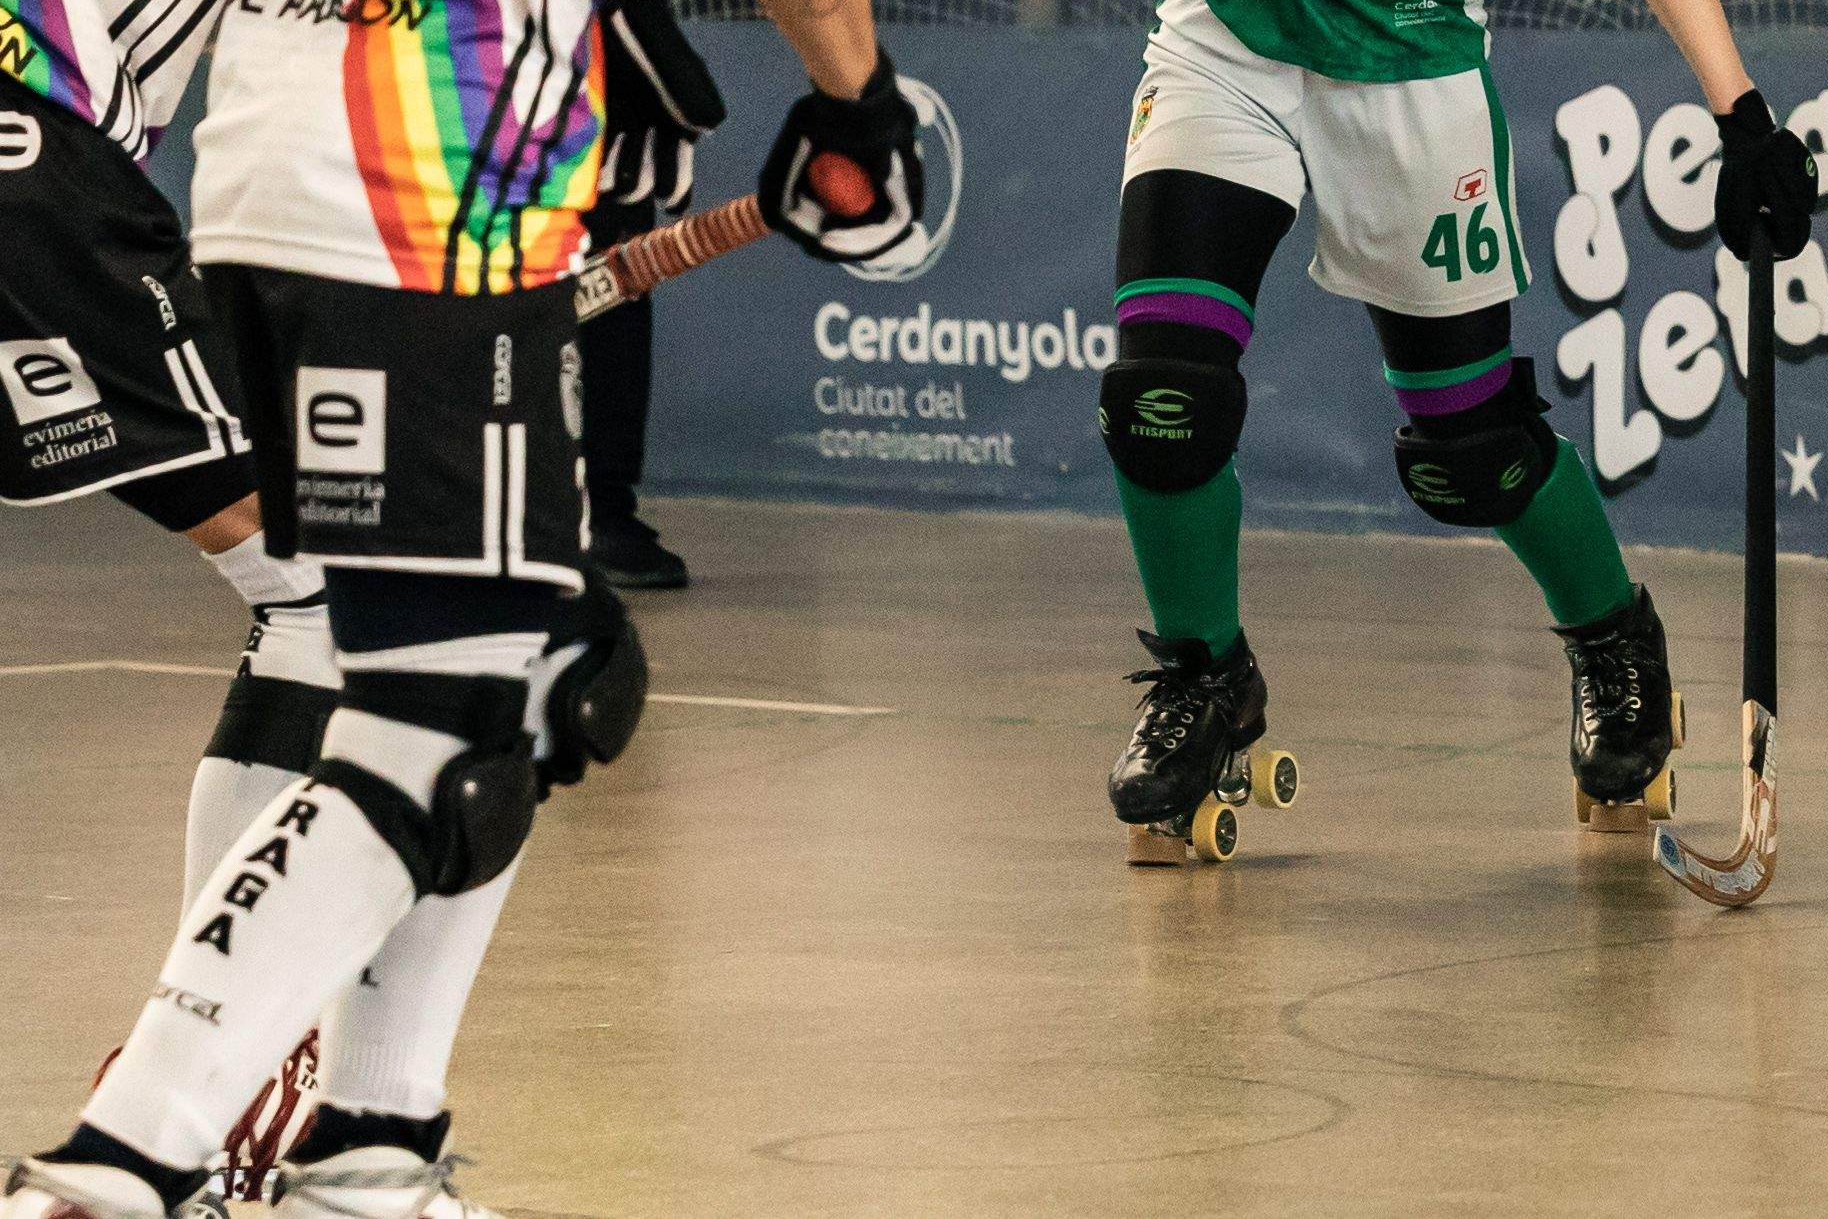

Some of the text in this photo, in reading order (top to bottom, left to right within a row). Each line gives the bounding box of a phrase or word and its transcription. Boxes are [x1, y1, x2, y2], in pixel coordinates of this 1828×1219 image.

[1420, 202, 1500, 284] 46
[813, 301, 1118, 383] Cerdanyola
[308, 390, 365, 448] e
[814, 377, 966, 421] Ciutat del
[30, 425, 119, 470] editorial
[817, 423, 1015, 468] coneixement
[193, 793, 320, 957] RAGA
